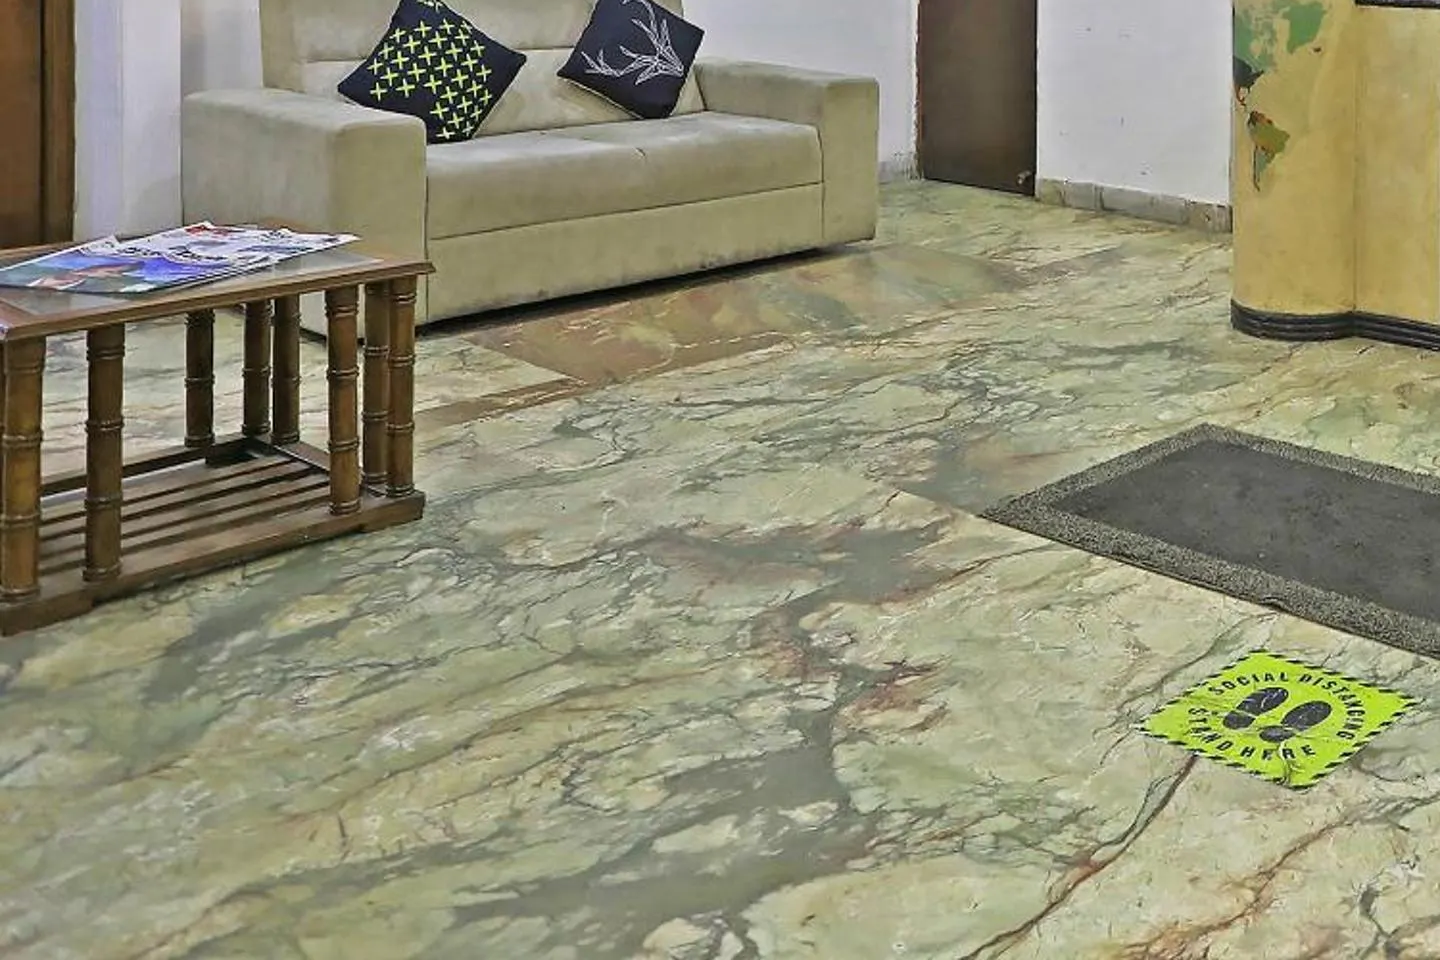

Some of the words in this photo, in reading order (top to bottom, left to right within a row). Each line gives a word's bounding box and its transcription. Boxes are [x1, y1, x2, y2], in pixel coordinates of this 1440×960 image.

[1188, 707, 1236, 753] STAND
[1240, 743, 1316, 761] HERE
[1208, 671, 1291, 696] SOCIAL
[1299, 672, 1366, 741] DISTANCING
